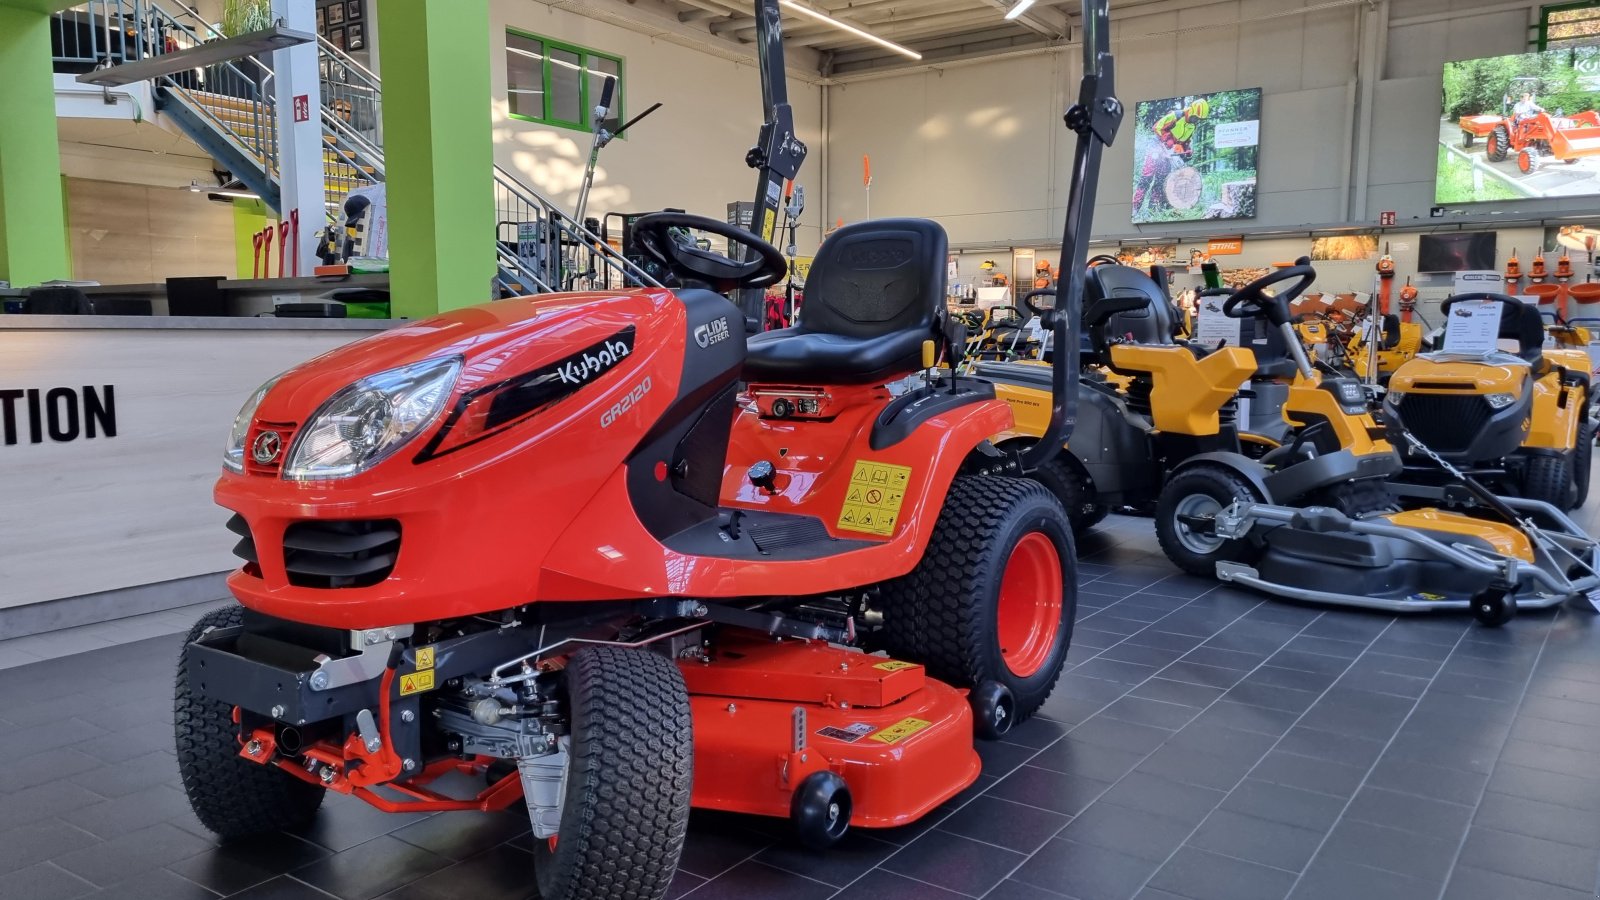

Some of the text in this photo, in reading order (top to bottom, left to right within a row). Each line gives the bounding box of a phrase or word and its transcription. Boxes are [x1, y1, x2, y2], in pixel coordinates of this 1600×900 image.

[1574, 58, 1600, 73] Ku
[694, 316, 728, 349] GLIDE
[709, 330, 730, 345] STEER
[557, 340, 630, 384] Kubota
[0, 385, 117, 445] TION
[600, 375, 652, 428] GR2120
